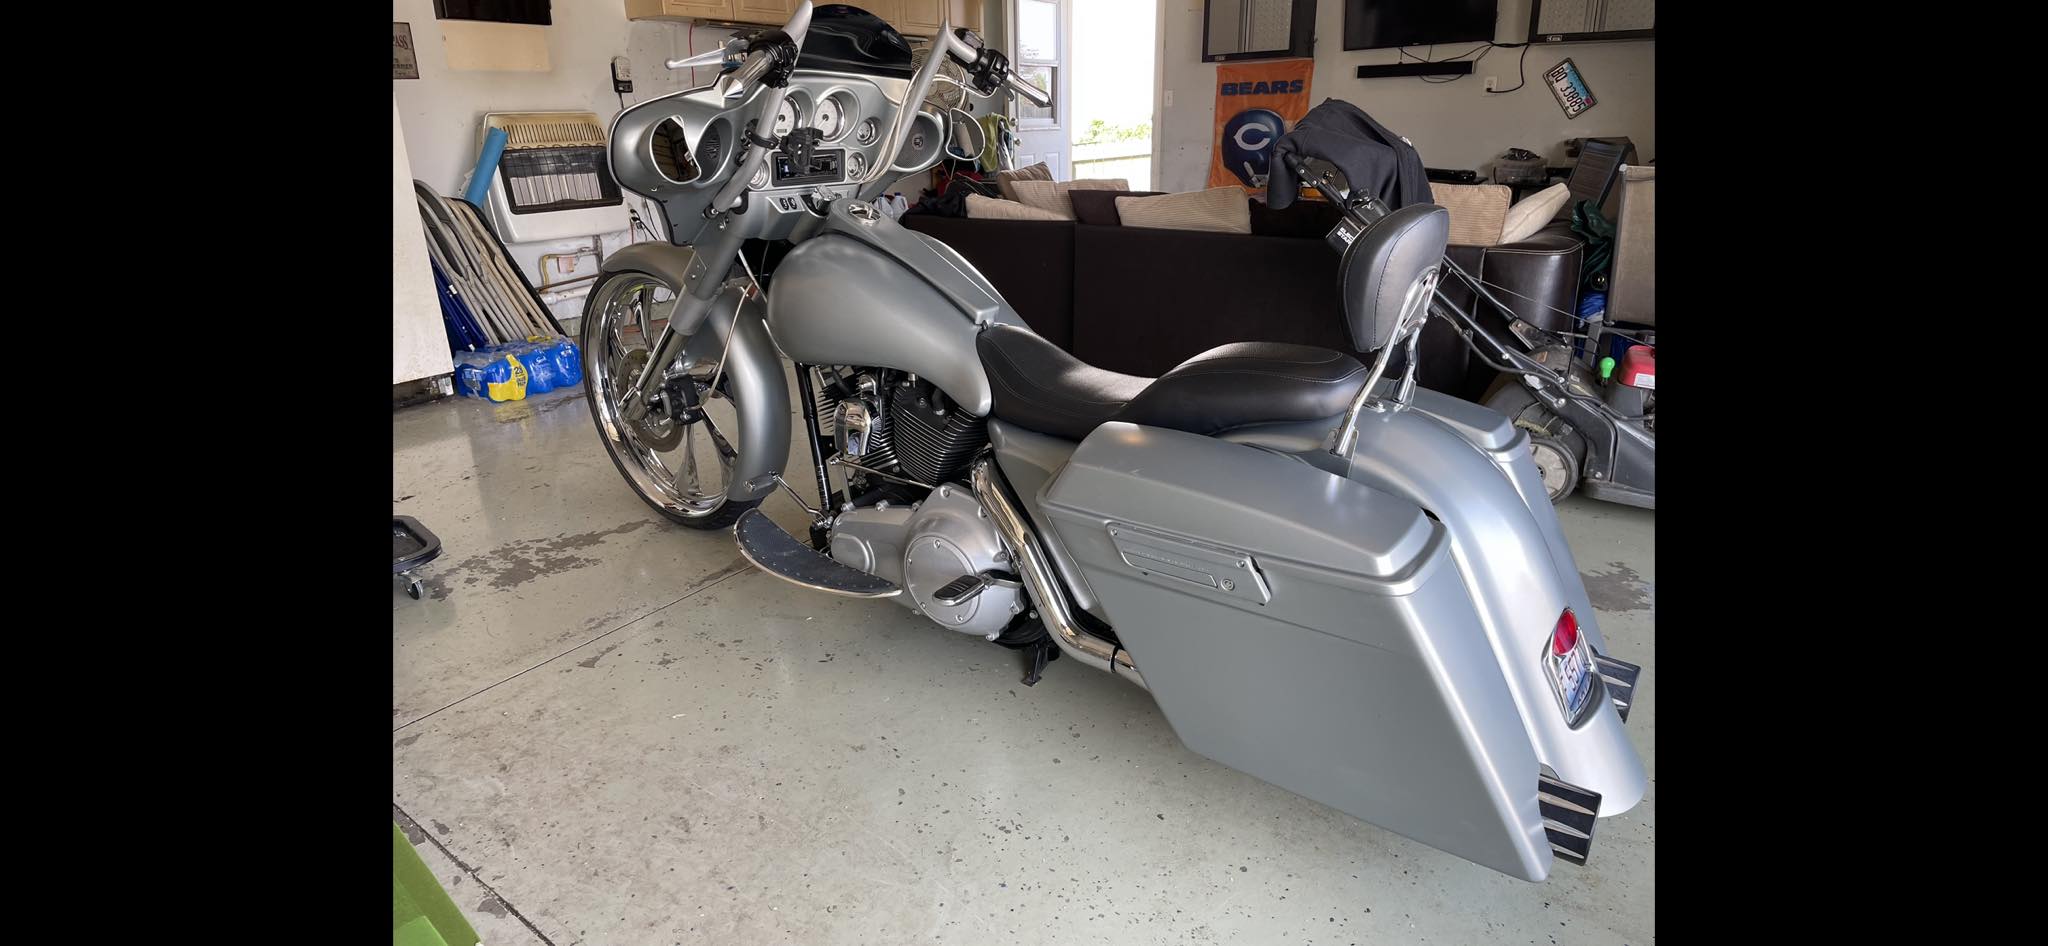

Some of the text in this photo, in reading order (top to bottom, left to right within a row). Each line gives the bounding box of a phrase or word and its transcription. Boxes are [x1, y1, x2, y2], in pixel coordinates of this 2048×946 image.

[1221, 80, 1304, 96] BEARS
[1560, 81, 1586, 113] 33885
[1233, 122, 1271, 151] C
